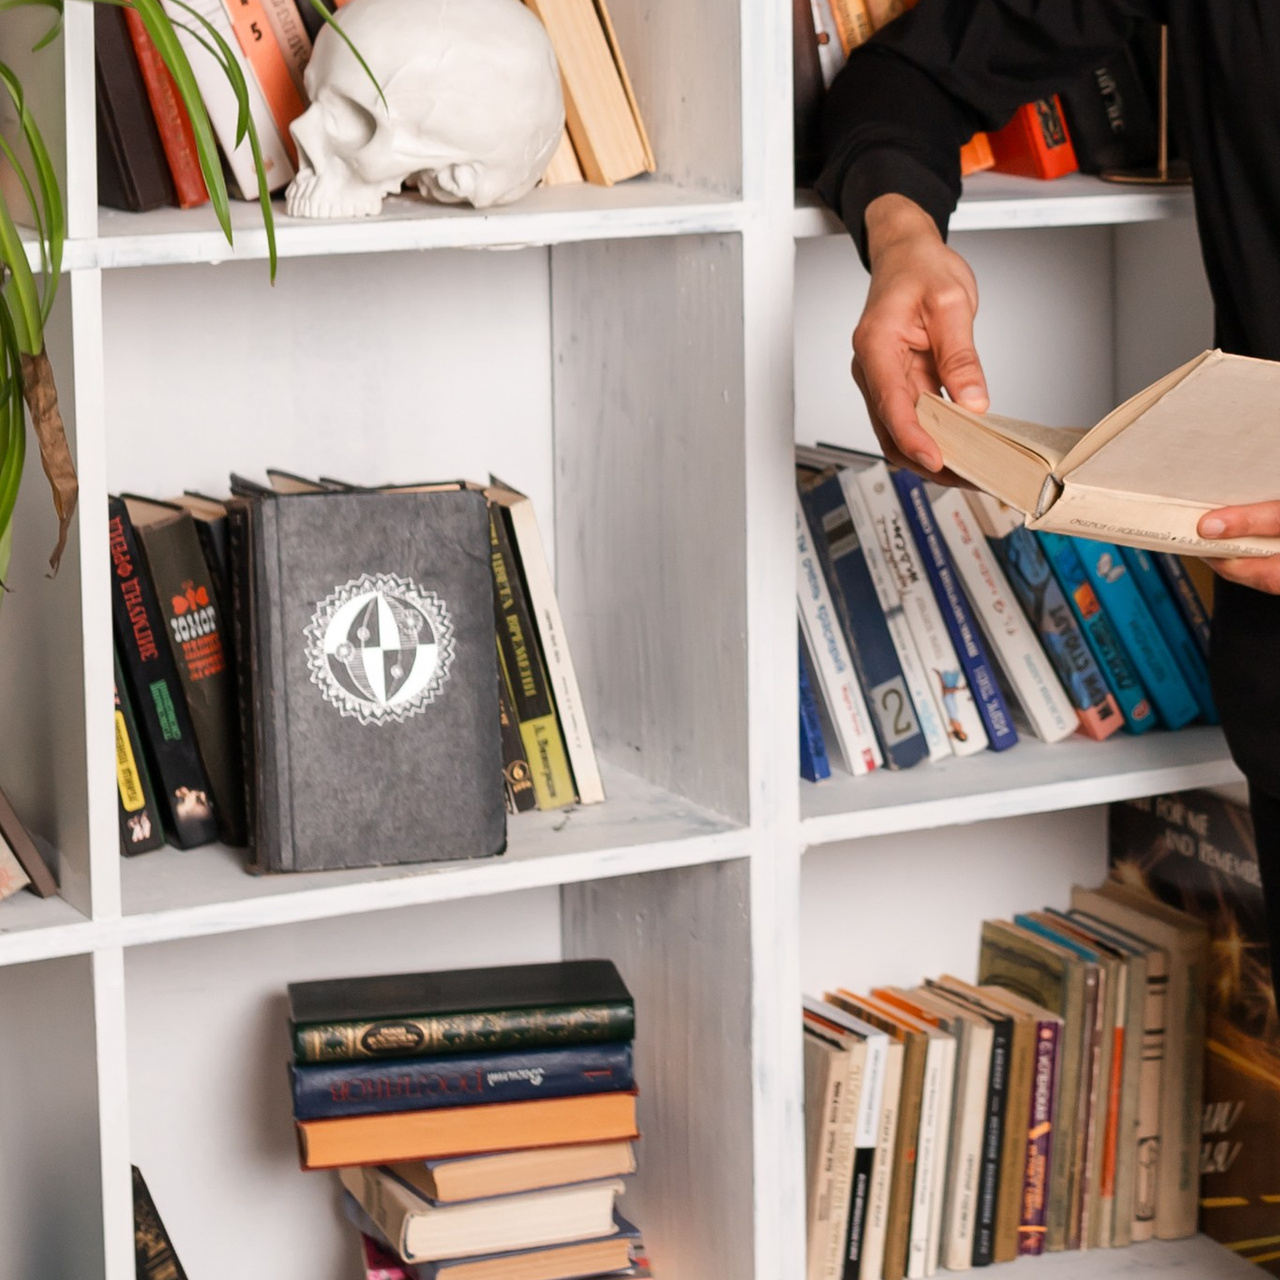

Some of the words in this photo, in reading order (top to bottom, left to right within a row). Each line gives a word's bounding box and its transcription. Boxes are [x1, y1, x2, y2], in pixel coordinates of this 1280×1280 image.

[248, 21, 264, 41] 5
[104, 514, 135, 579] ФРЕЙД
[118, 575, 159, 661] ЗИГМУНД
[1047, 603, 1092, 674] СТЮАРТ
[505, 614, 536, 698] ВРЕМЕНИ
[880, 687, 912, 738] 2
[1080, 671, 1115, 721] МЭРИ
